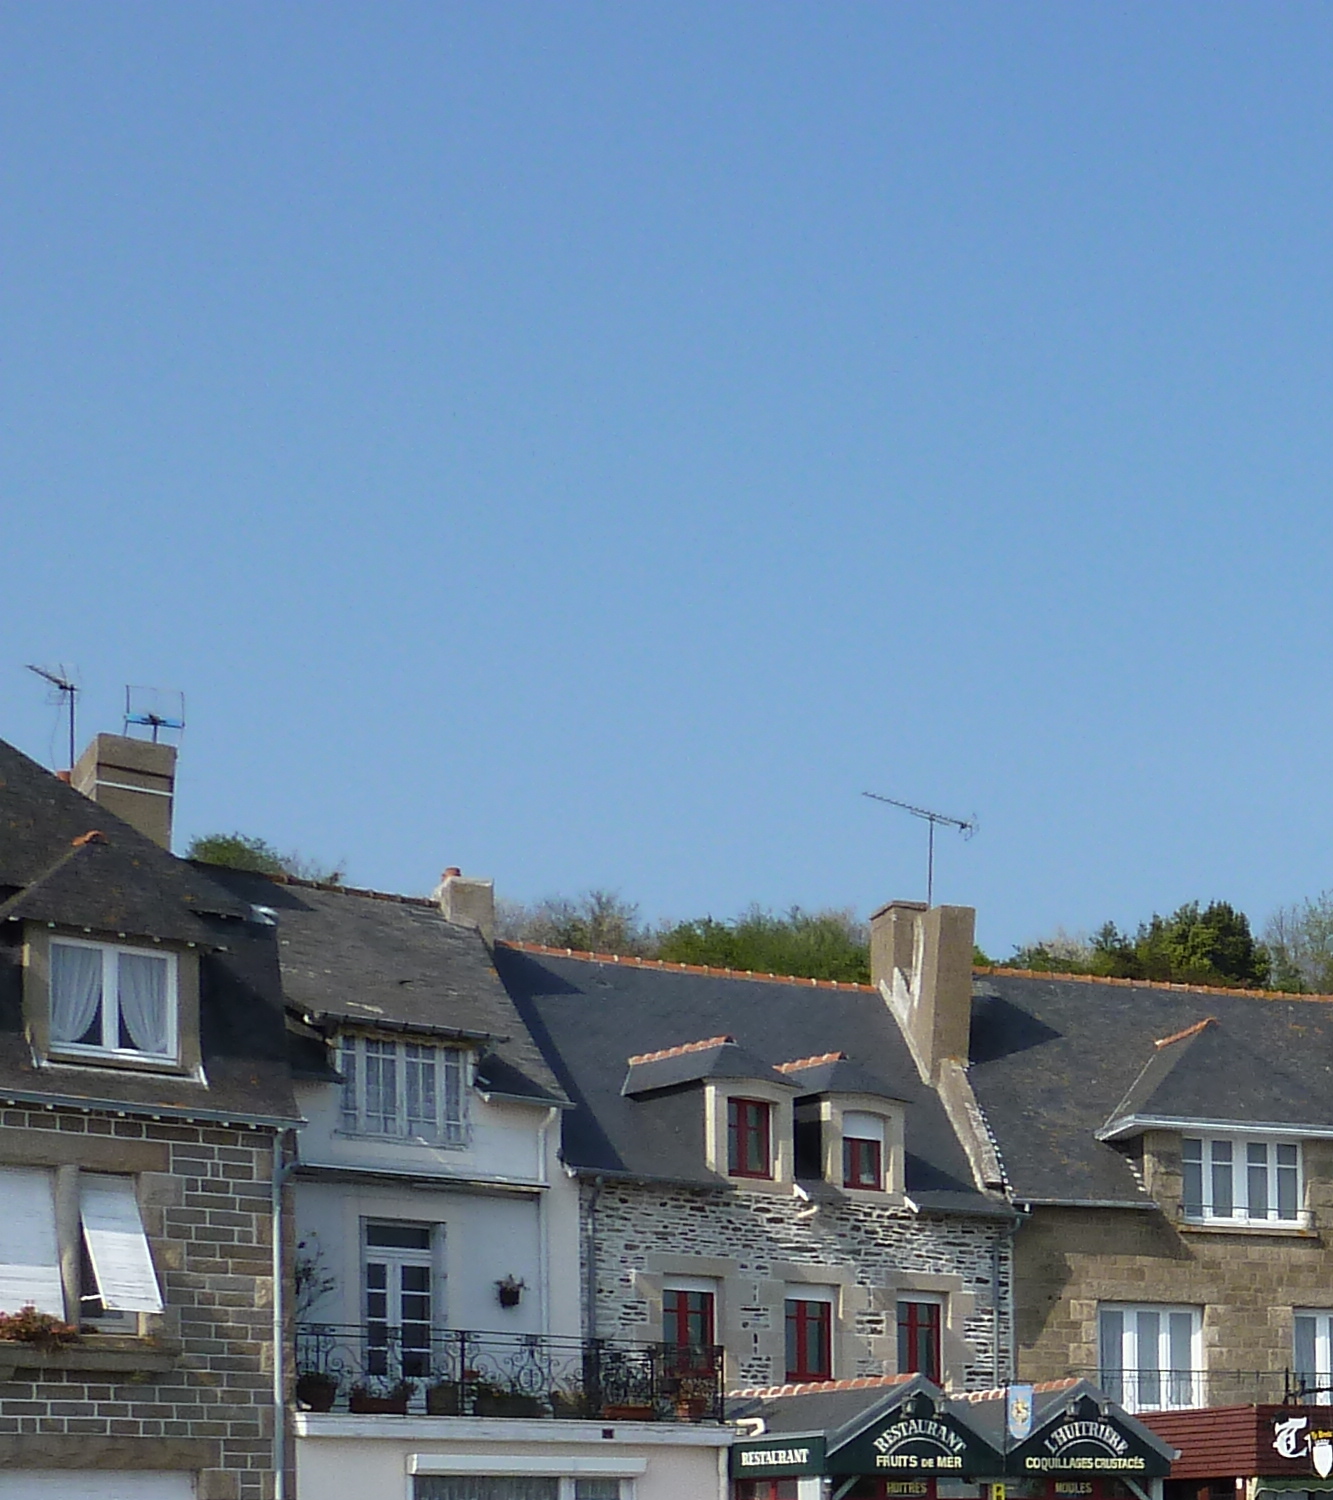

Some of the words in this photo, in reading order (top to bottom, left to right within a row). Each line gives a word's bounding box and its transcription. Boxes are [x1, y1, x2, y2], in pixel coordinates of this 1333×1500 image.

[873, 1418, 968, 1453] RESTAURANT
[1272, 1416, 1312, 1458] T
[741, 1448, 809, 1467] RESTAURANT
[876, 1455, 919, 1468] FRUITS
[937, 1456, 963, 1468] MER
[1025, 1457, 1093, 1472] COQUILLAGES
